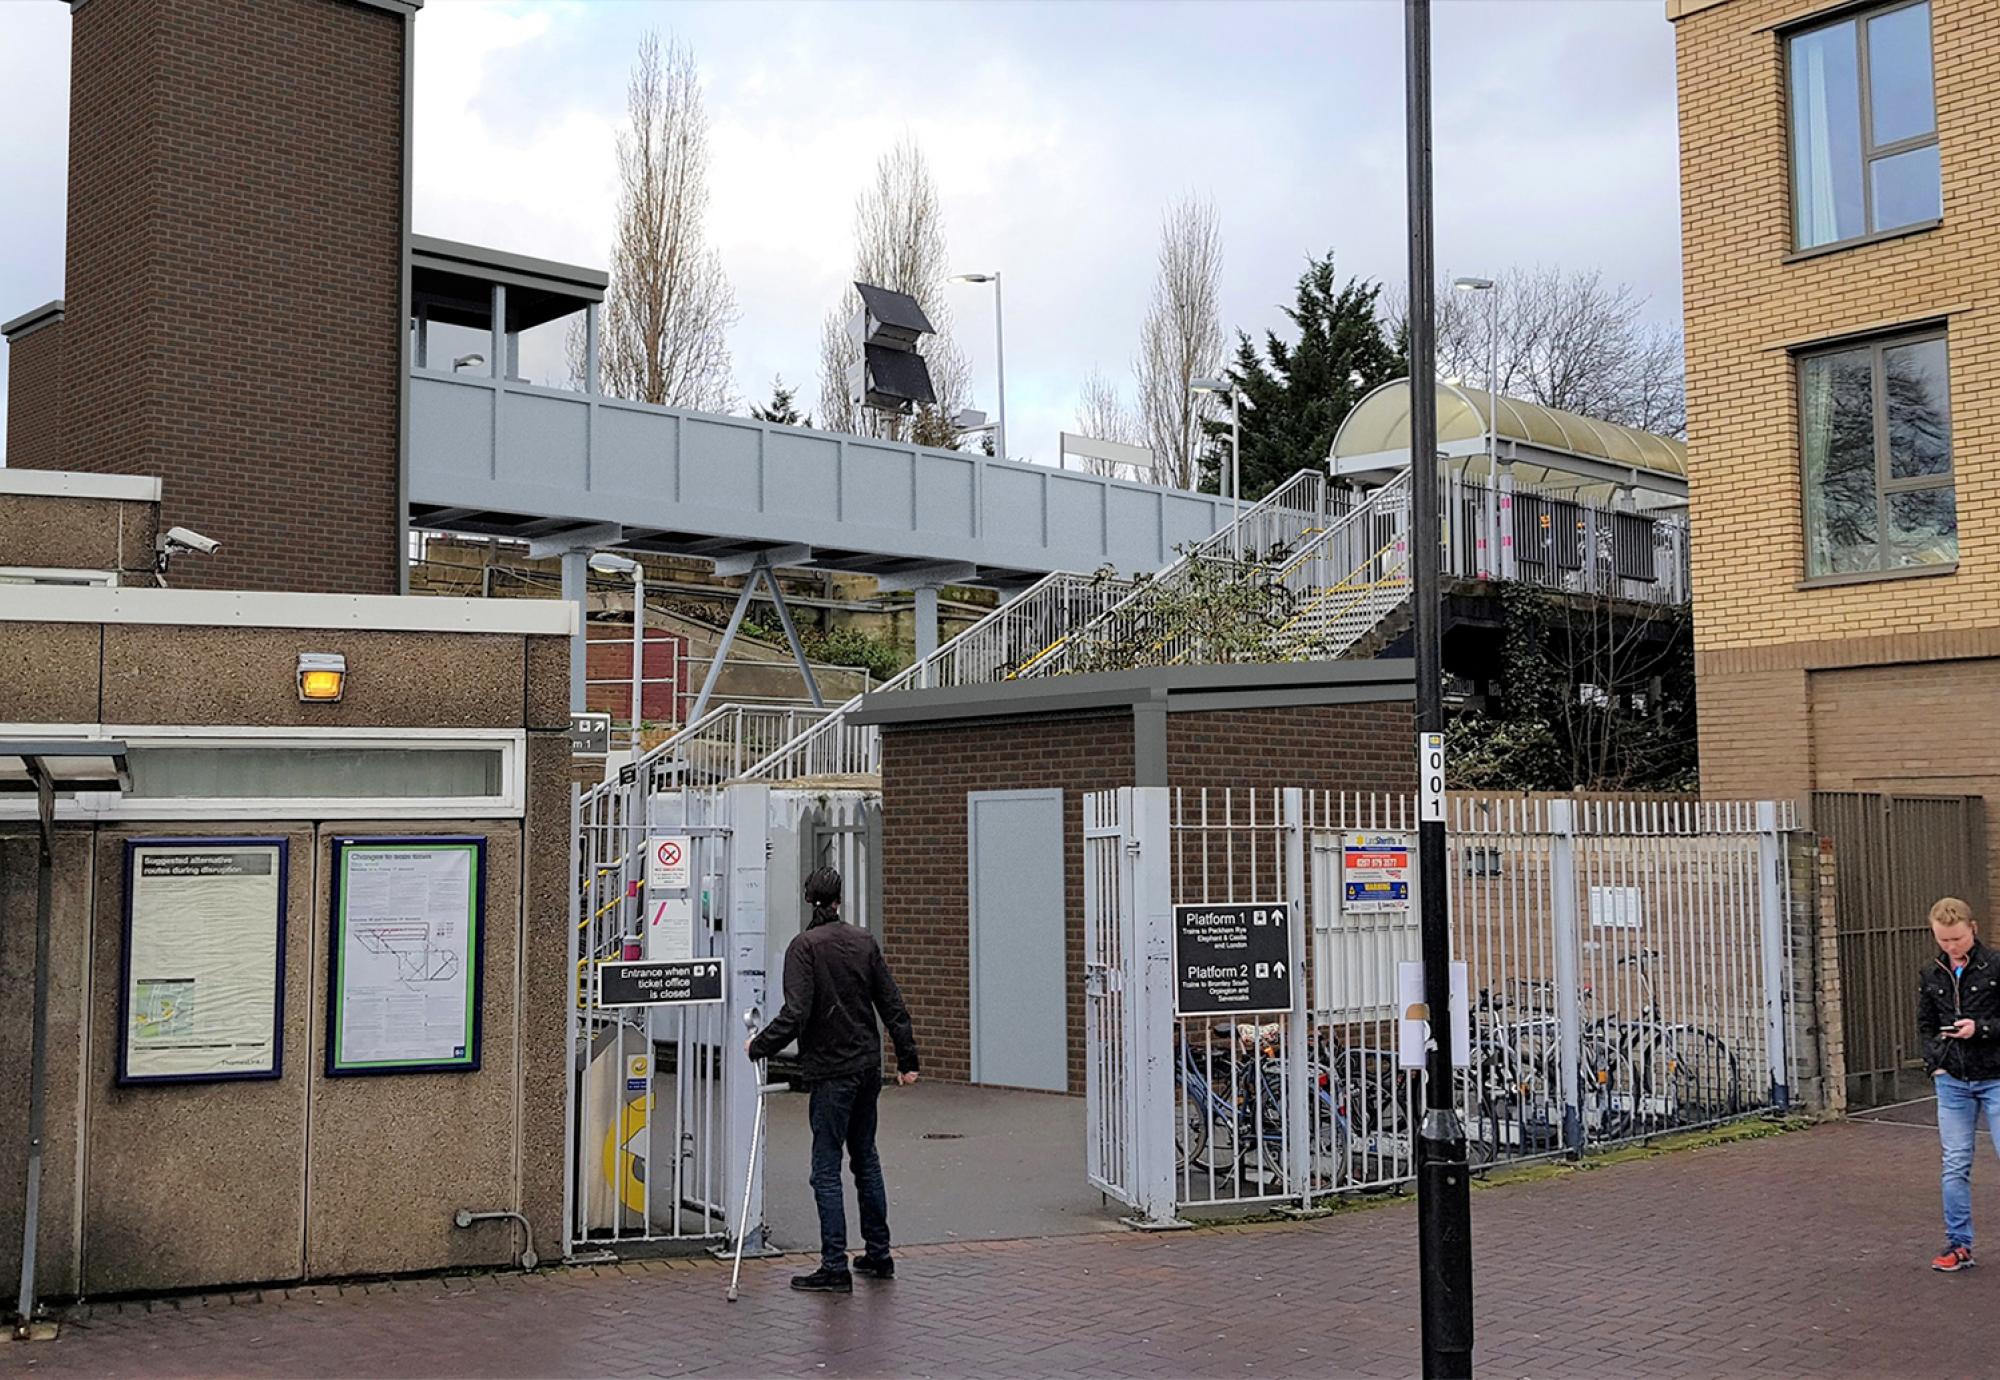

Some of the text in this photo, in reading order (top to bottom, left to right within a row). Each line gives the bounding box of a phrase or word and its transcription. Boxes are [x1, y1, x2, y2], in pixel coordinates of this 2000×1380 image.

[144, 857, 188, 866] Suggested
[172, 866, 199, 875] during
[201, 866, 242, 874] disruption
[1186, 912, 1245, 925] Platform 1
[621, 967, 690, 978] Entrance when
[1188, 964, 1248, 978] Platform 2
[638, 978, 690, 988] ticket office
[650, 989, 690, 999] is closed
